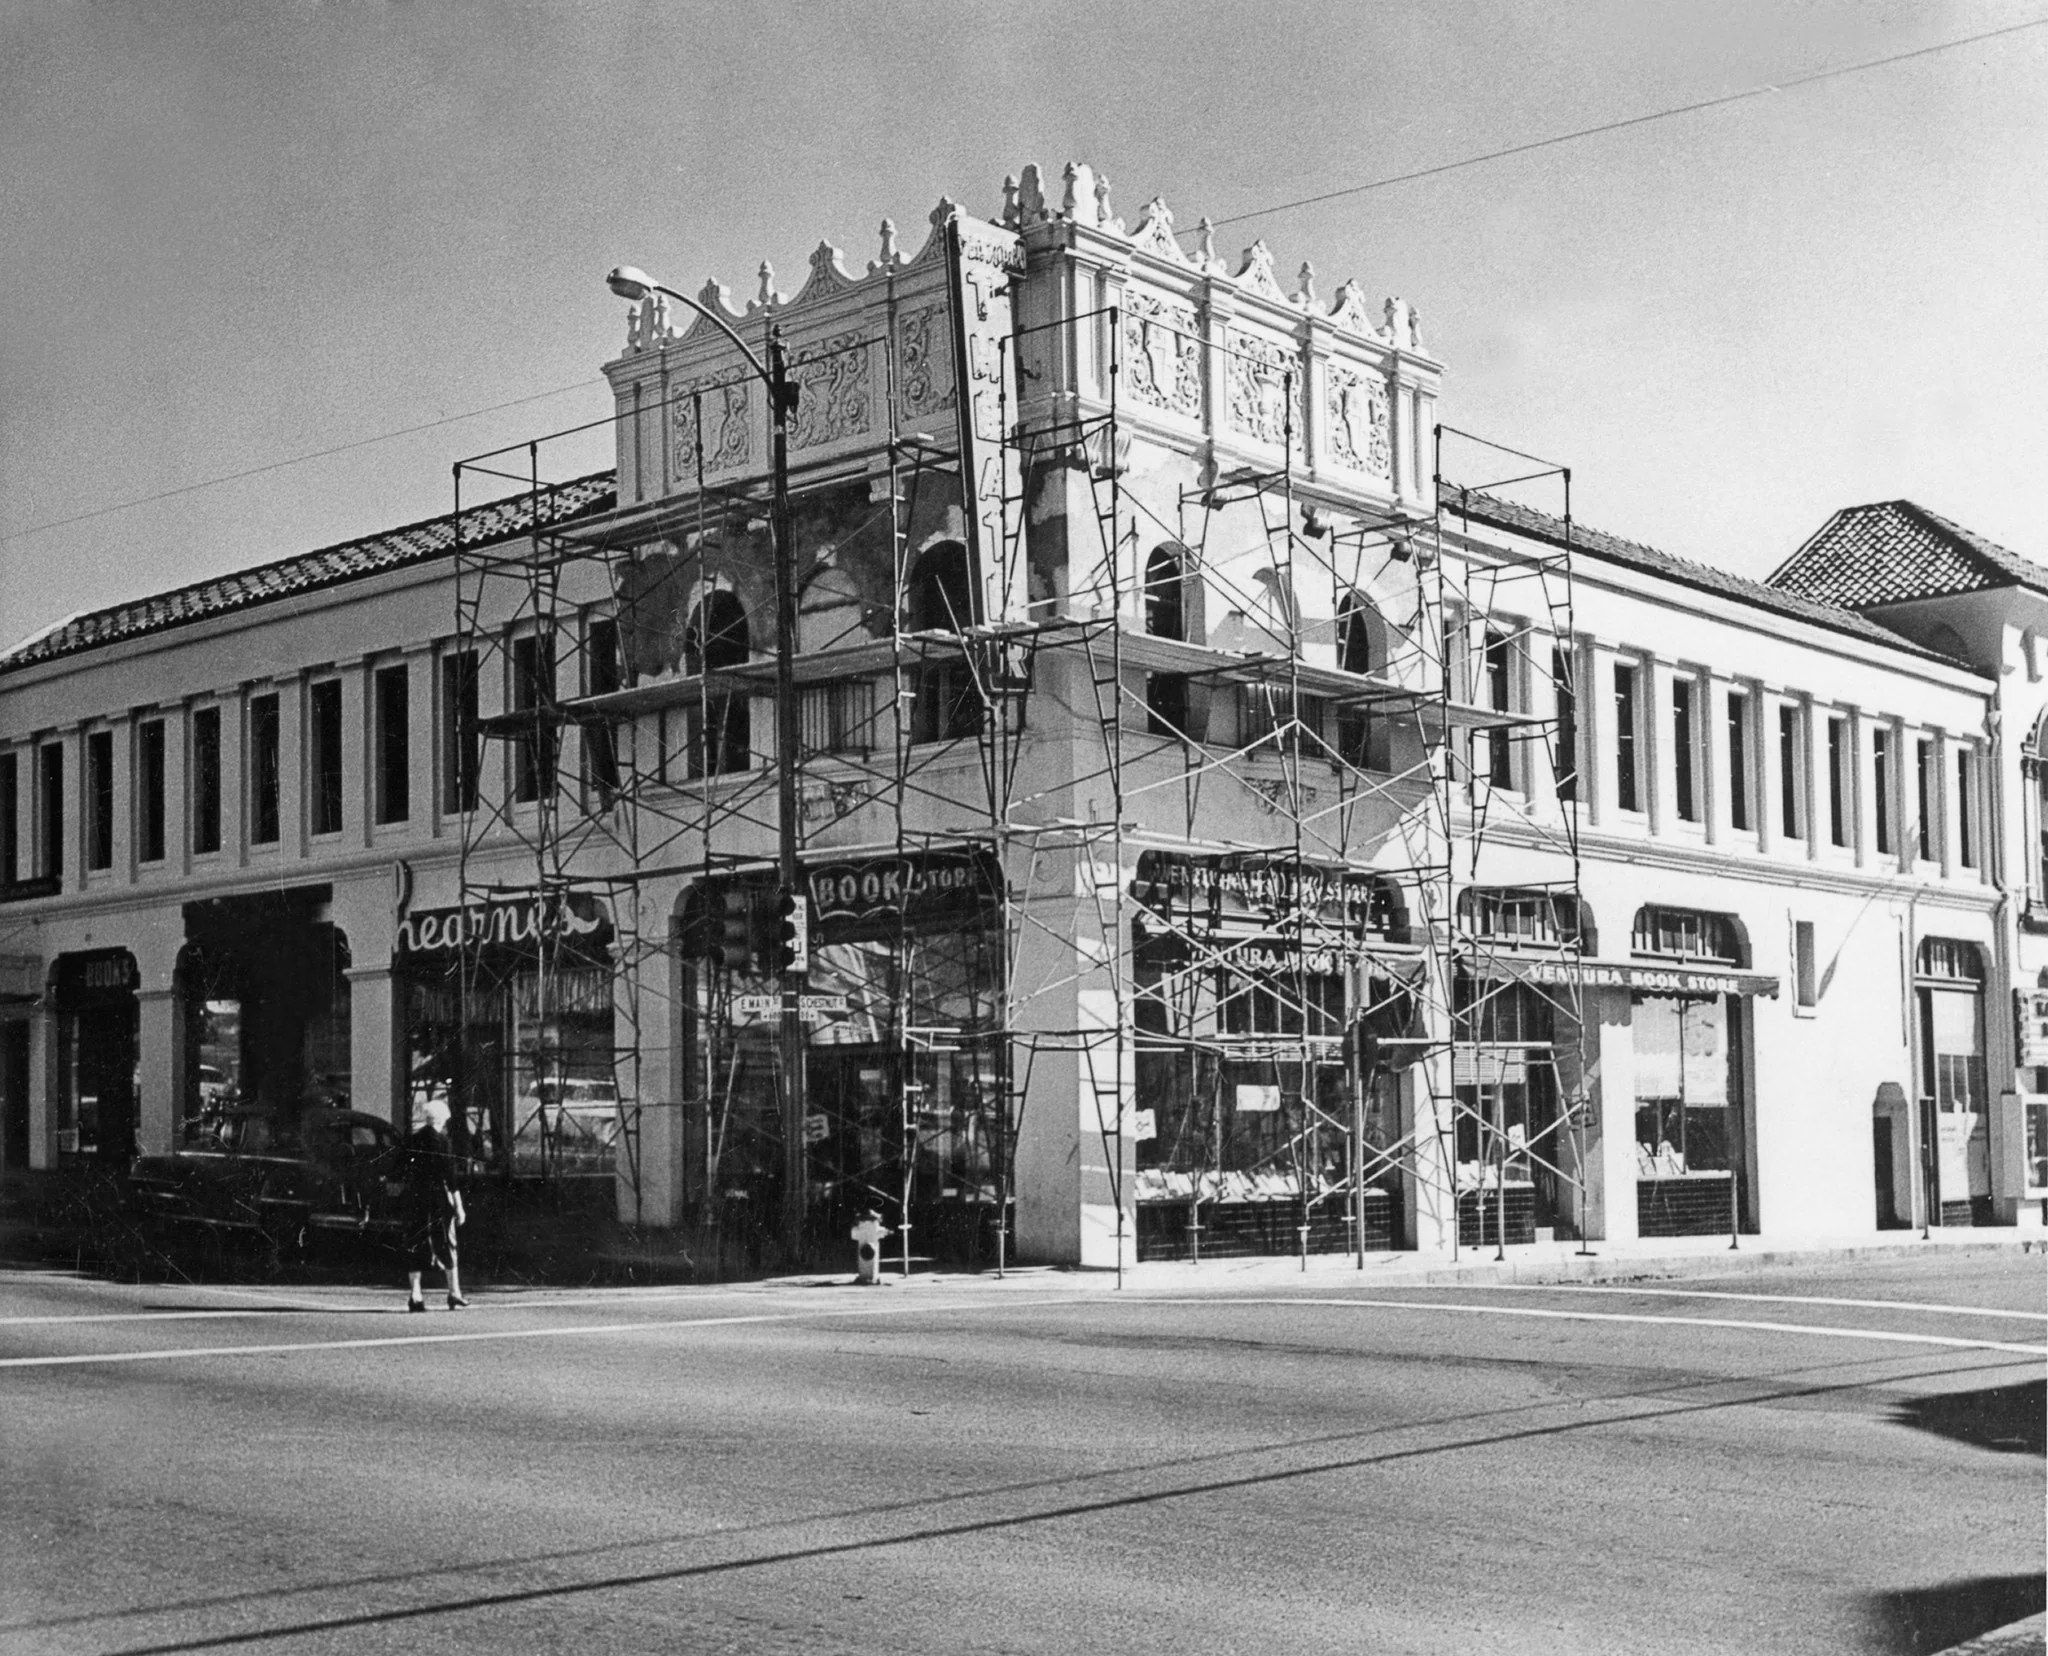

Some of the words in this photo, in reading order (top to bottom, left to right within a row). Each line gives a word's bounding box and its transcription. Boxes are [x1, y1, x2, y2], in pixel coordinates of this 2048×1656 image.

[818, 869, 900, 909] BOOK
[1528, 963, 1625, 987] VENTURA
[1630, 971, 1682, 991] BOOK
[1686, 975, 1739, 993] STORE
[748, 998, 770, 1009] MAIN
[807, 997, 838, 1009] CHESTNUT
